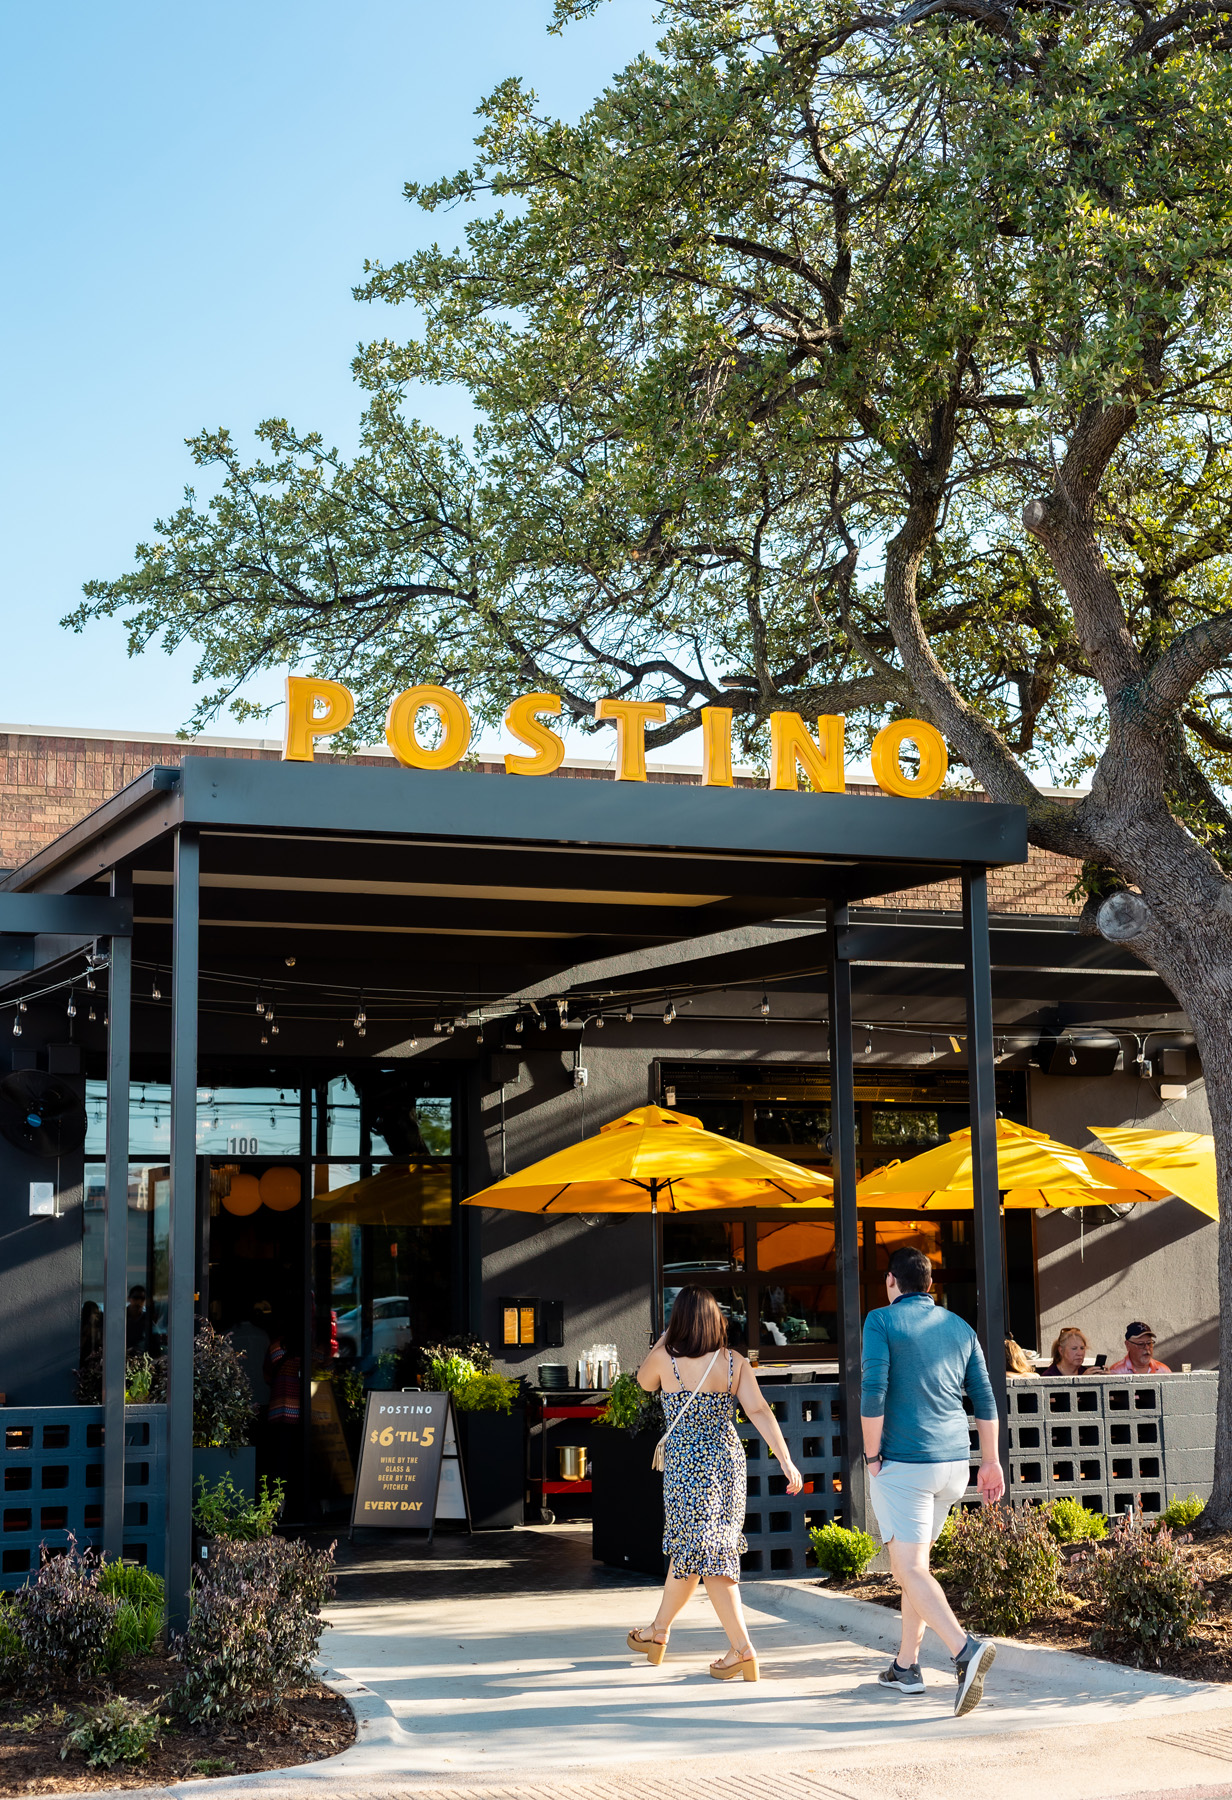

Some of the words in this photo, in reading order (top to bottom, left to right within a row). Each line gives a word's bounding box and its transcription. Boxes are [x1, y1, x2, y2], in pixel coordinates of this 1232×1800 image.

[282, 676, 949, 799] POSTINO
[230, 1137, 258, 1155] 100
[379, 1405, 433, 1414] POSTINO
[370, 1426, 394, 1447] $6
[420, 1427, 435, 1447] 5
[380, 1456, 396, 1464] WINE
[397, 1456, 406, 1464] BY
[407, 1456, 419, 1464] THE
[385, 1465, 404, 1473] GLASS
[405, 1465, 411, 1473] &
[377, 1474, 394, 1482] BEER
[395, 1474, 404, 1482] BY
[404, 1474, 416, 1482] THE
[383, 1483, 409, 1491] PITCHER
[364, 1501, 399, 1510] EVERY
[400, 1501, 423, 1511] DAY
